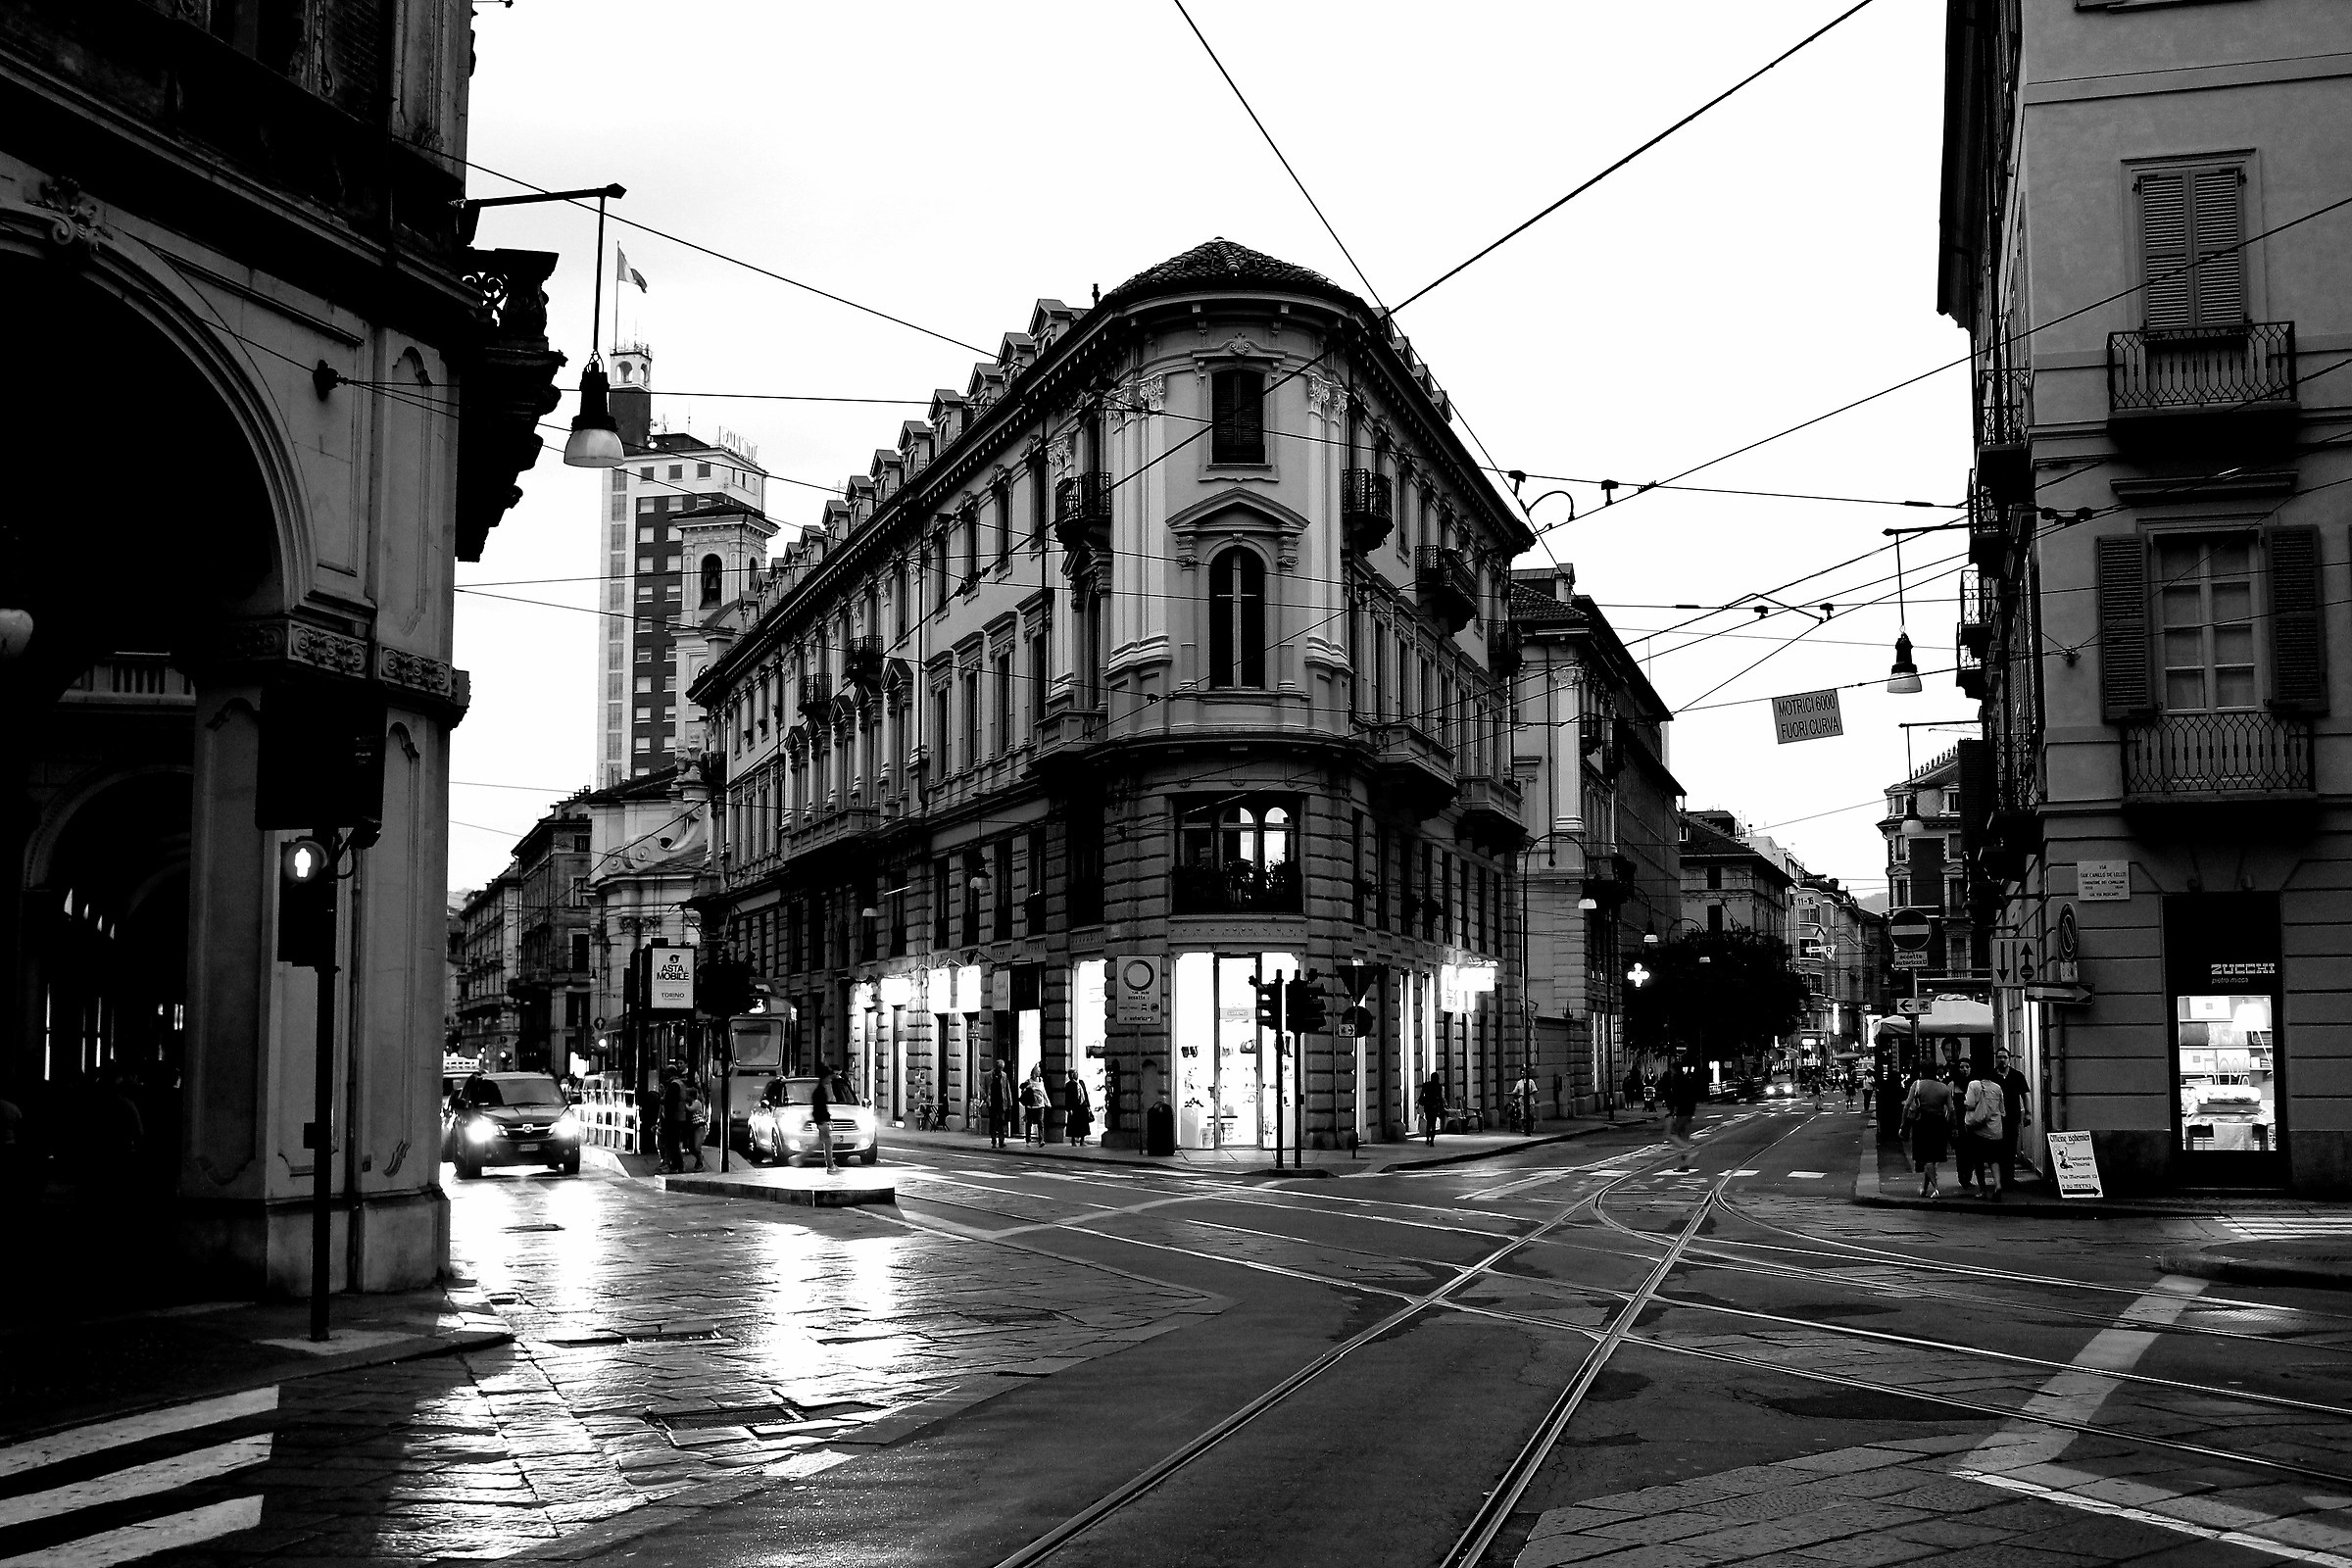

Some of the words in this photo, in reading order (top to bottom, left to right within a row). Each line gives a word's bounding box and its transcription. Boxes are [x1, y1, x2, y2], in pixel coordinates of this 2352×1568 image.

[1778, 697, 1815, 716] MOTRICI
[1815, 694, 1836, 711] 6000
[1781, 720, 1808, 739] FUORI
[1809, 716, 1839, 735] CURVA
[1826, 946, 1833, 955] R
[2211, 963, 2275, 975] ZUCCHI
